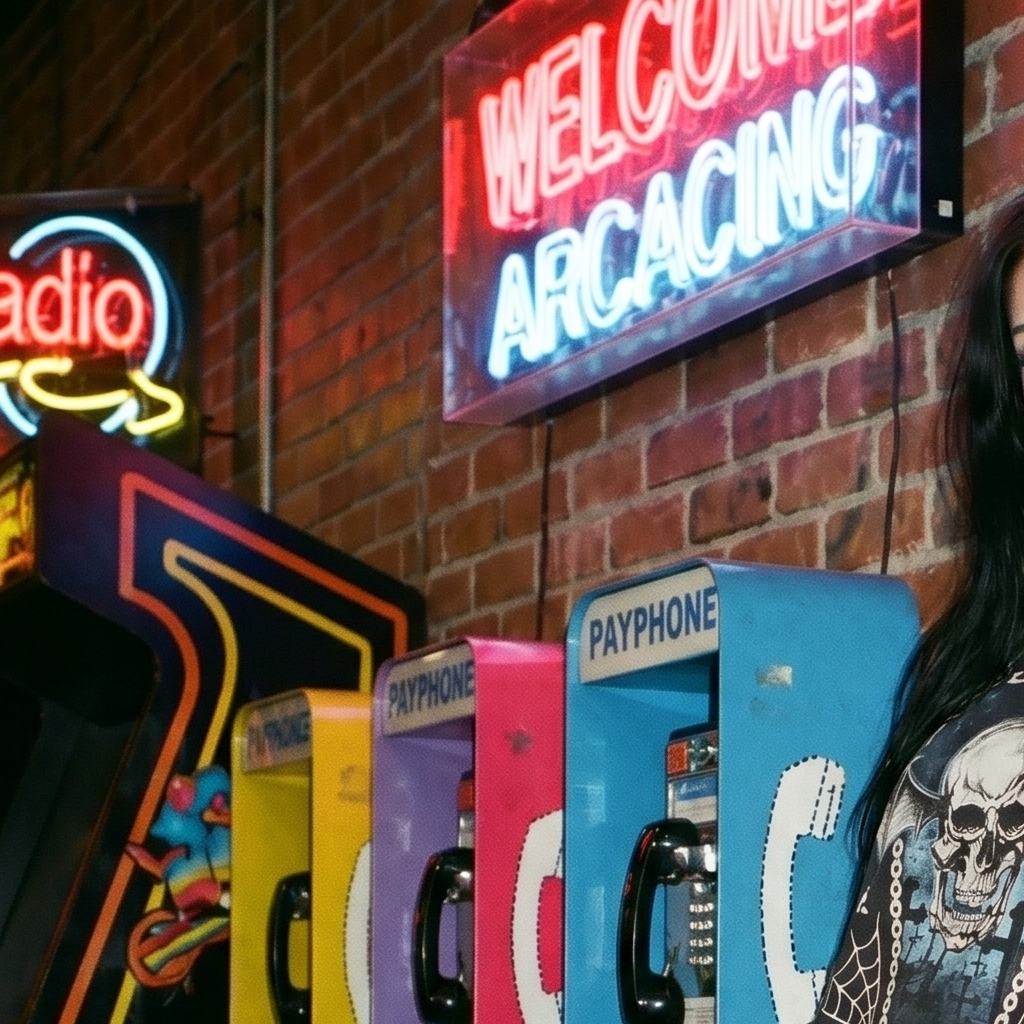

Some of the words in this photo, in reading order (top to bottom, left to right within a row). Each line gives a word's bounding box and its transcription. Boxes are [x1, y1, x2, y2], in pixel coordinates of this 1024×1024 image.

[487, 64, 884, 380] ARCACING
[589, 585, 718, 661] PAYPHONE
[388, 659, 475, 720] PAYPHONE
